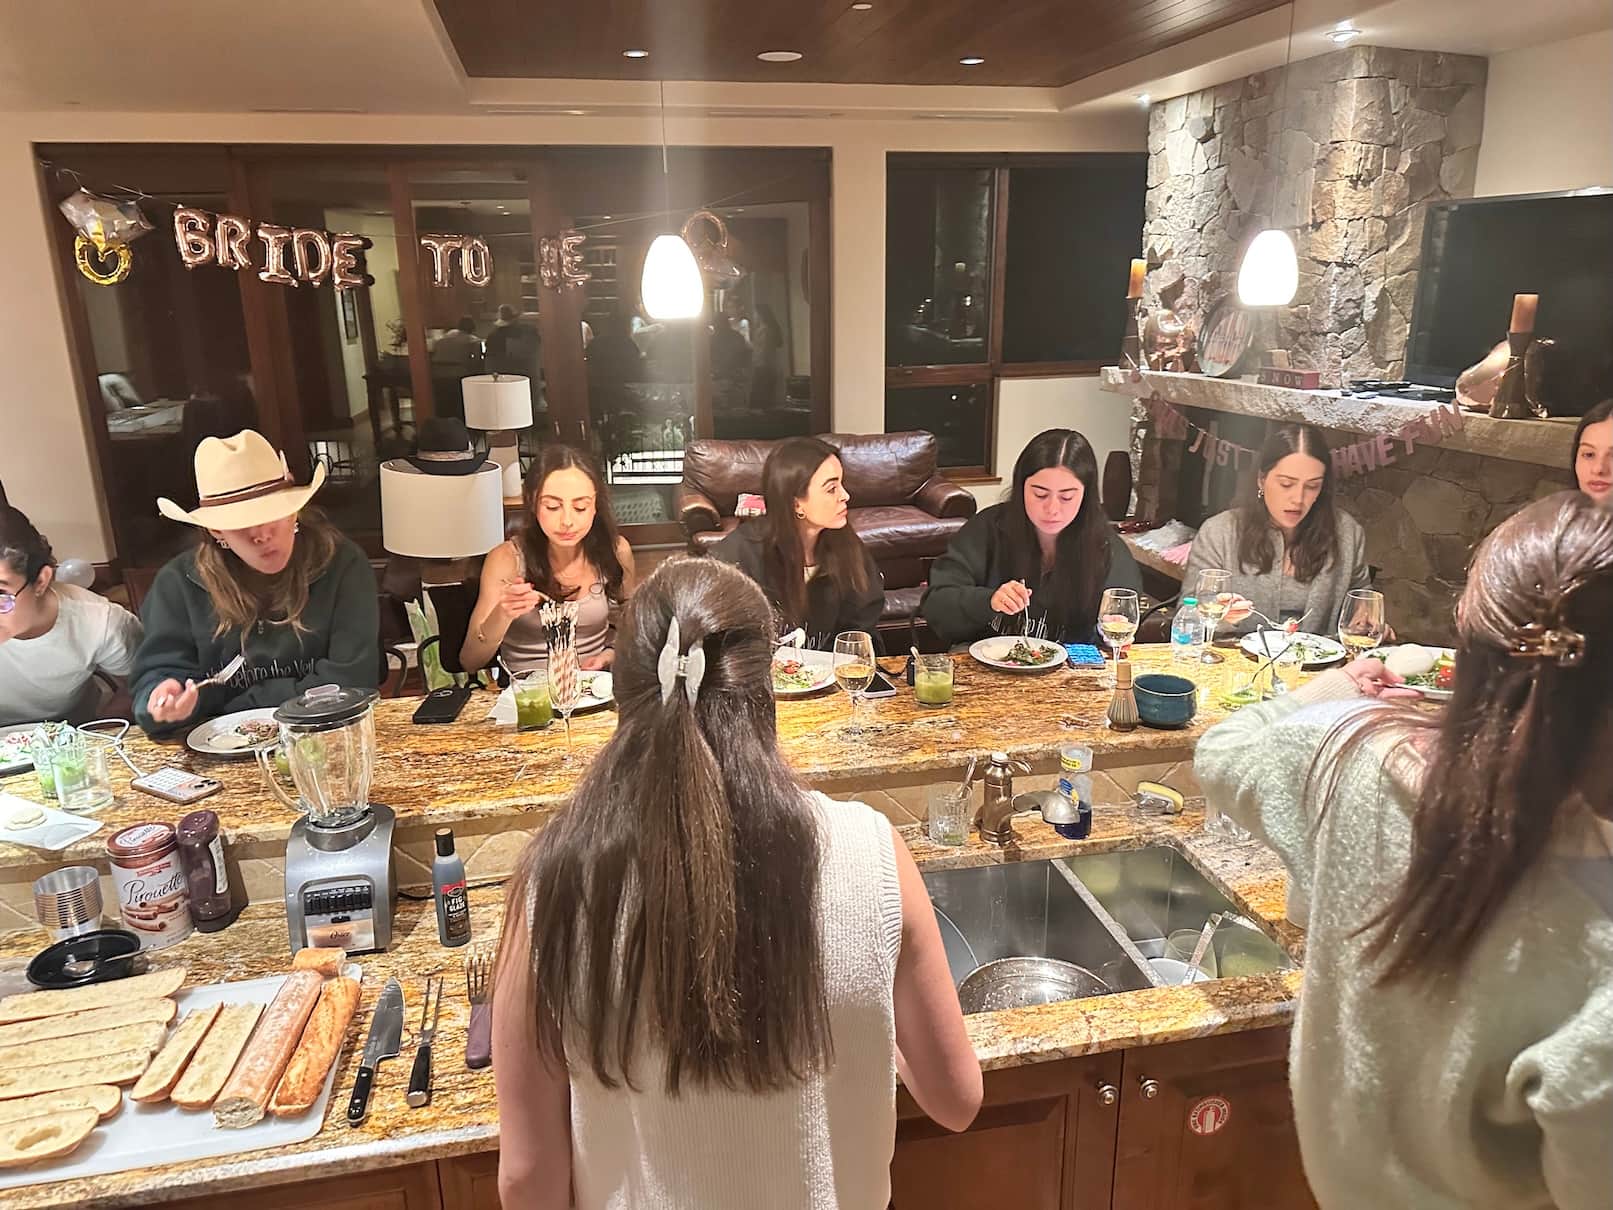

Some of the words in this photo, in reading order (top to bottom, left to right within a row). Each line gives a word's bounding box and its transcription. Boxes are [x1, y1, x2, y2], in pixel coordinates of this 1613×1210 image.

[174, 205, 374, 290] BRIDE
[421, 233, 494, 287] TO
[1188, 428, 1242, 471] JUST
[1330, 434, 1397, 477] HAVE
